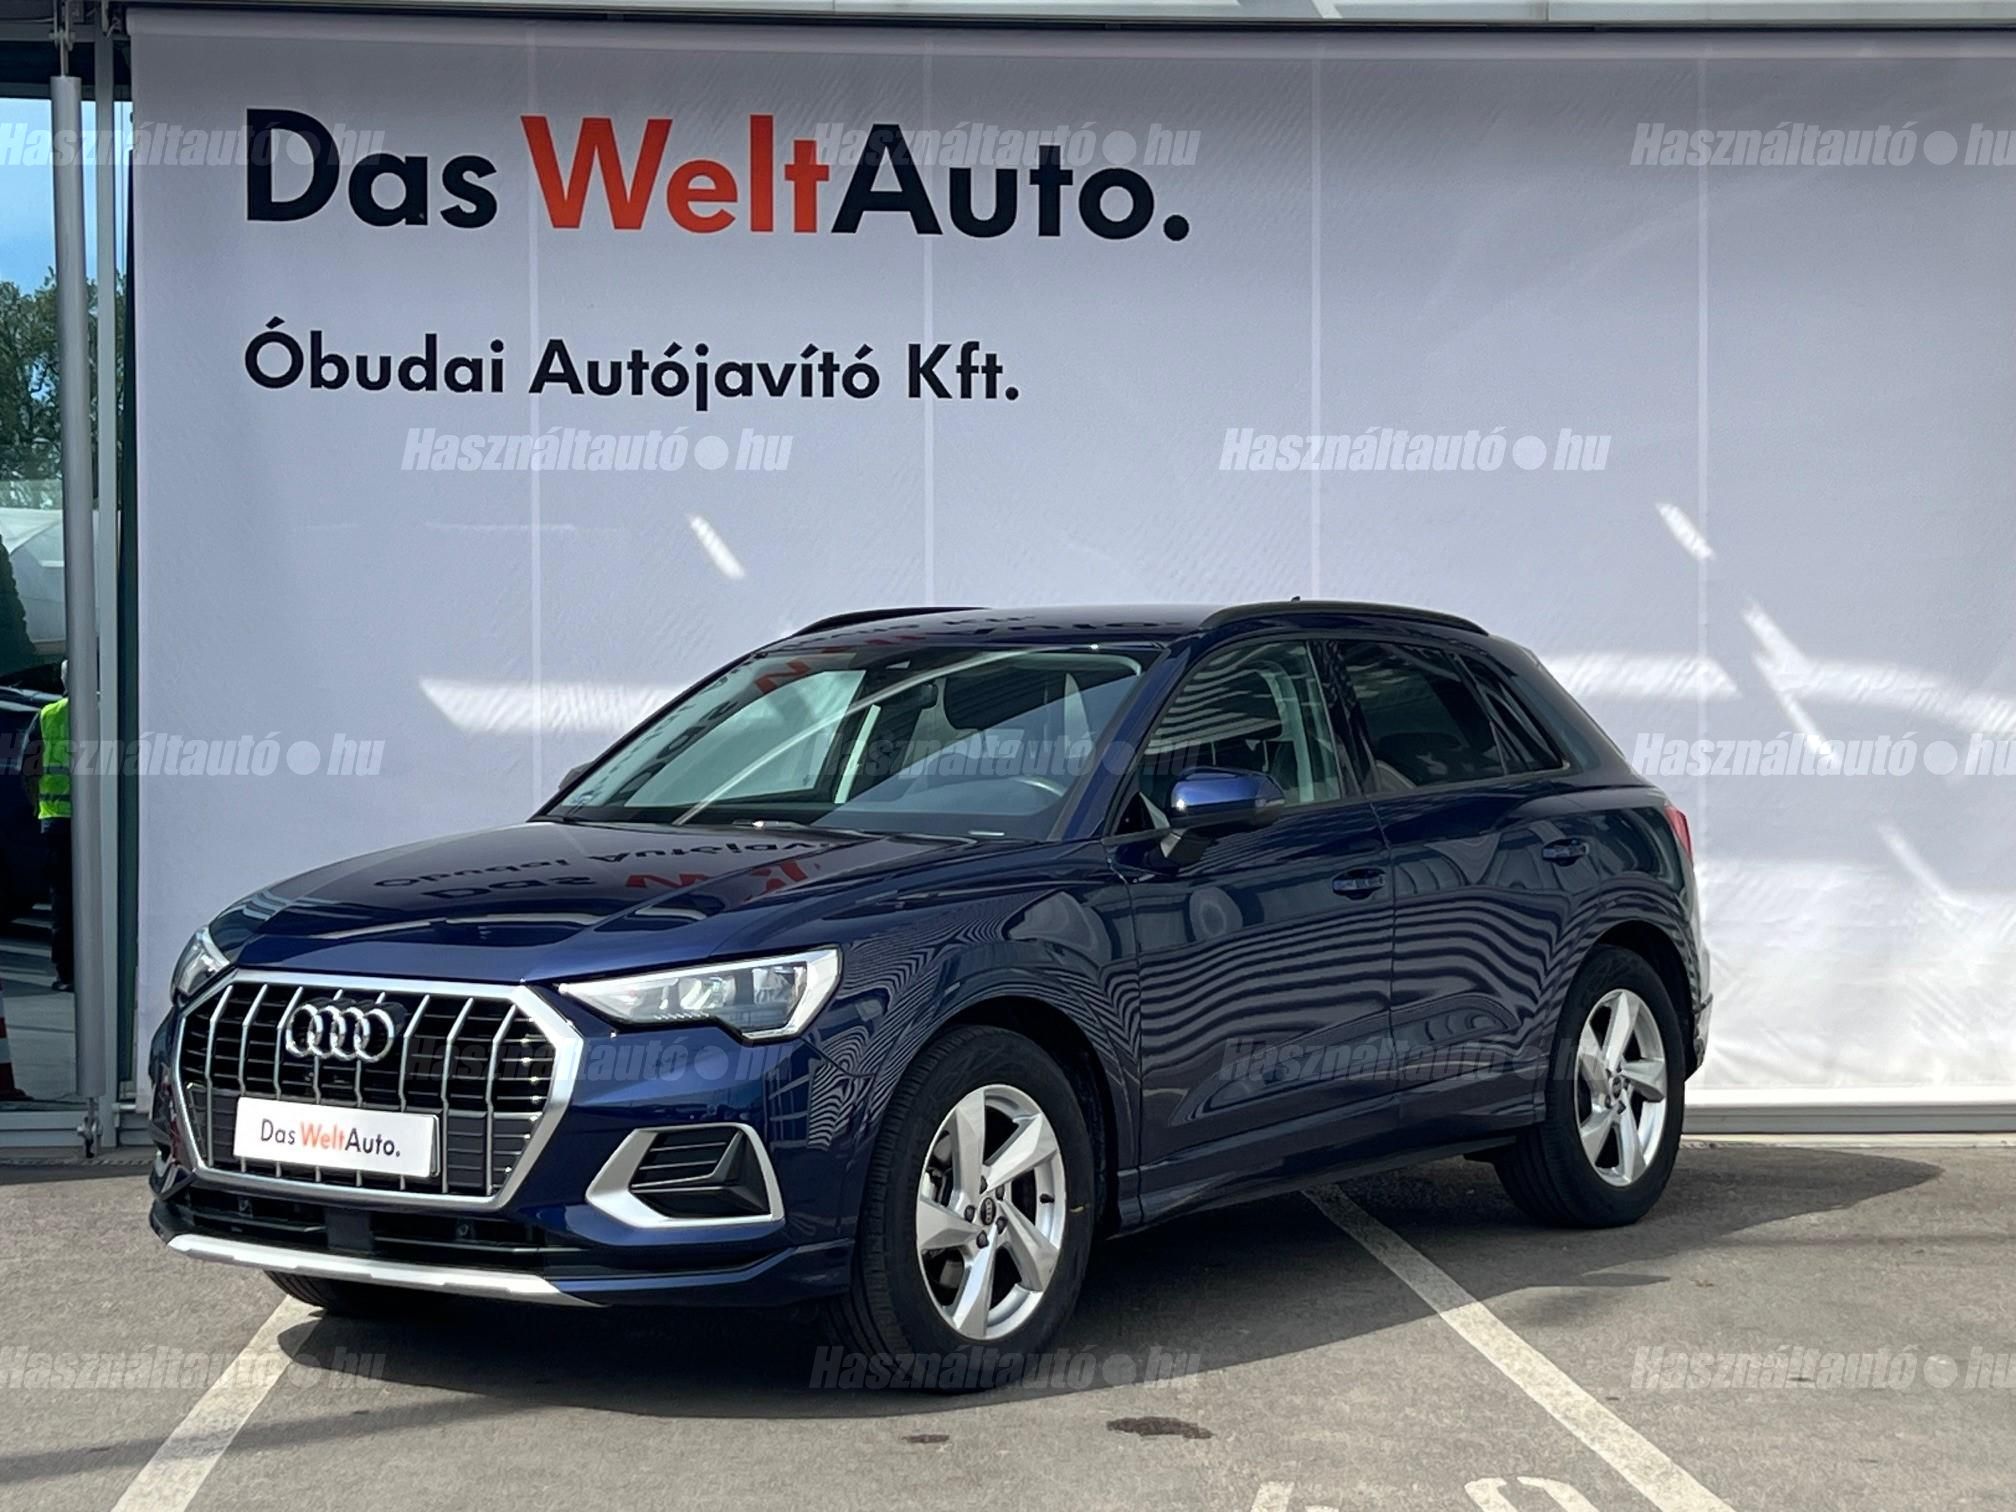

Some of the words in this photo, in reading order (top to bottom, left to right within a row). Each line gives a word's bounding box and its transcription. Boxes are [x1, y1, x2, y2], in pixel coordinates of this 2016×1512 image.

[246, 108, 498, 229] Das
[520, 114, 1191, 241] WeltAuto.
[244, 316, 504, 393] Óbudai
[528, 341, 881, 411] Autójavító
[908, 340, 1020, 401] Kft.
[260, 1118, 296, 1145] Das
[300, 1121, 401, 1158] WeltAuto.
